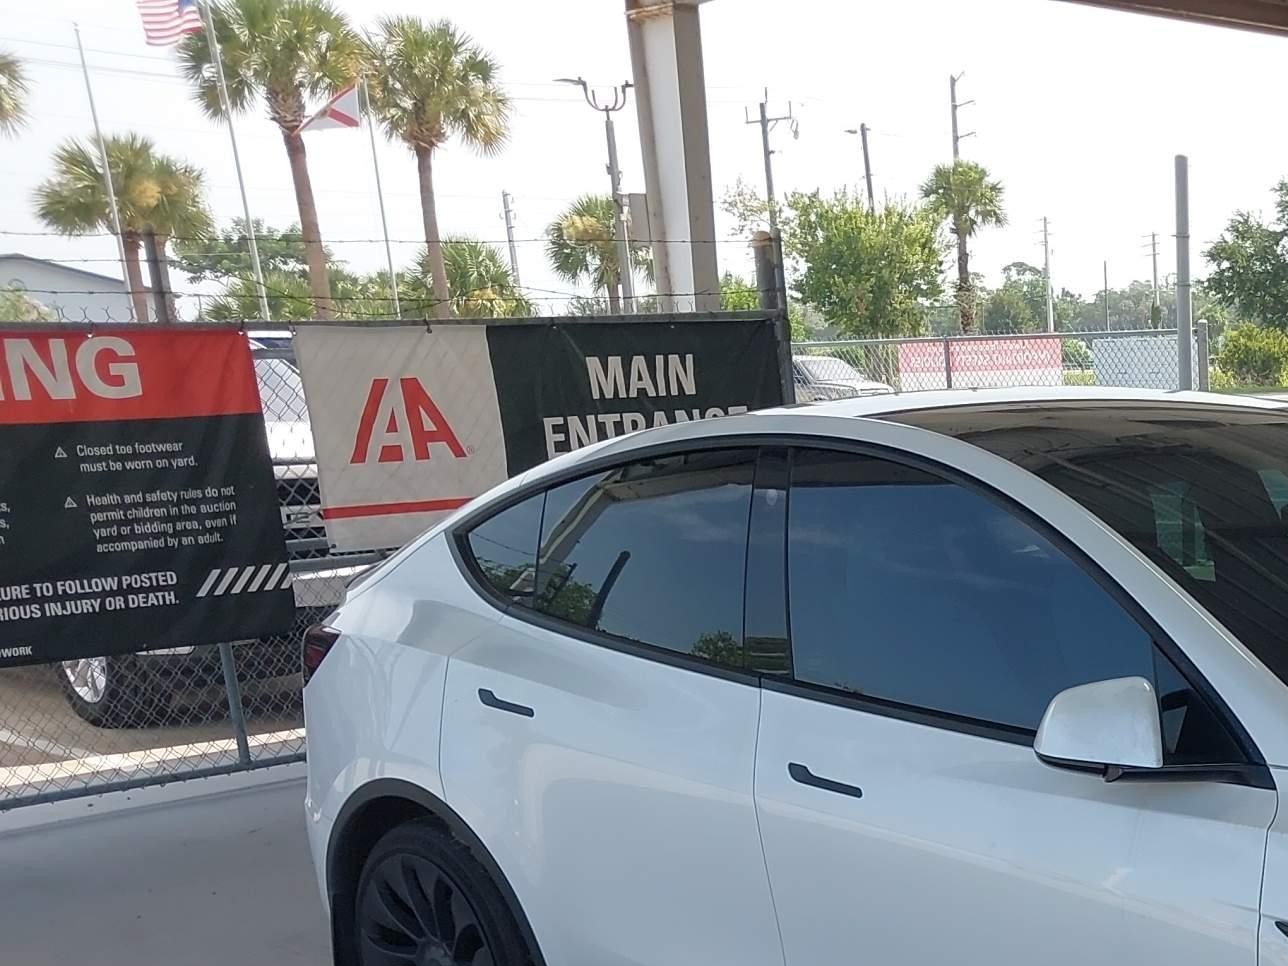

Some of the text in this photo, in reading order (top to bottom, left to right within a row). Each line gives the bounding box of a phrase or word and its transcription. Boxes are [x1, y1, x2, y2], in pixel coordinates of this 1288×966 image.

[0, 336, 143, 400] NG
[585, 354, 696, 399] MAIN
[76, 442, 183, 457] Closed toe footwear
[80, 455, 198, 473] must be worn on yard.
[86, 485, 236, 507] Health and safety rules do not
[90, 500, 237, 526] permit children in the auction
[93, 513, 238, 541] yard or bidding area, even if
[96, 531, 224, 552] accompanied by an adult.
[0, 571, 178, 601] URE TO FOLLOW POSTED
[44, 598, 101, 617] INJURY
[105, 596, 126, 611] OR
[127, 591, 180, 608] DEATH.
[0, 645, 33, 658] WORK
